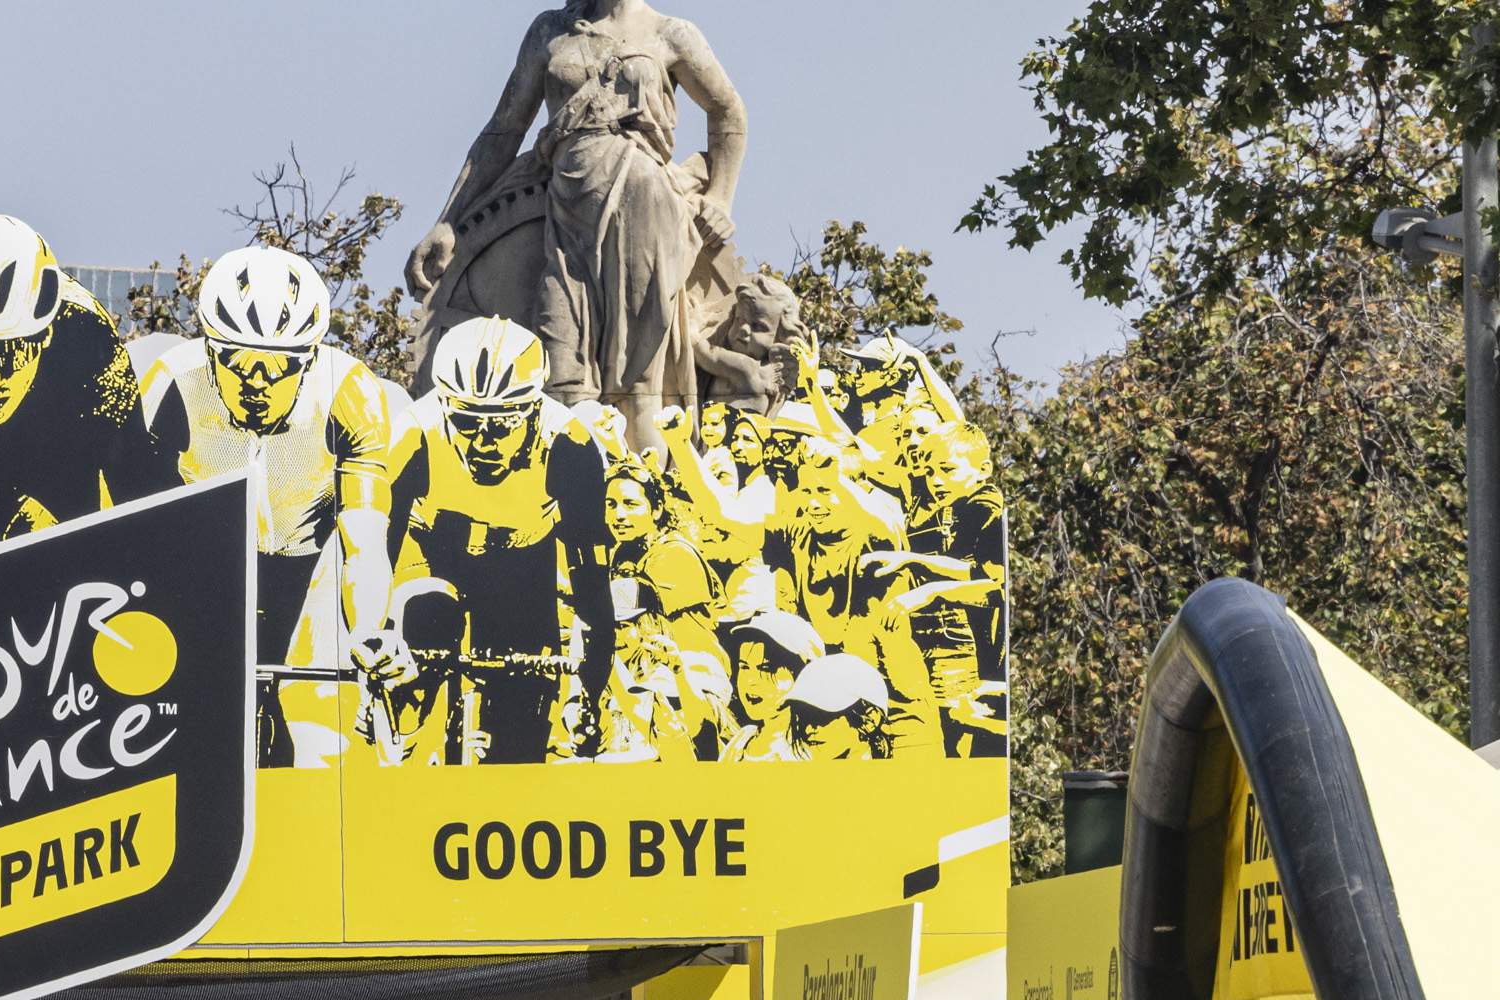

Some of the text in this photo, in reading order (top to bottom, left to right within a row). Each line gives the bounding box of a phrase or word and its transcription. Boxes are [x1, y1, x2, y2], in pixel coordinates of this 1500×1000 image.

[52, 672, 99, 720] de
[1, 813, 142, 908] PARK
[433, 818, 747, 881] GOOD BYE
